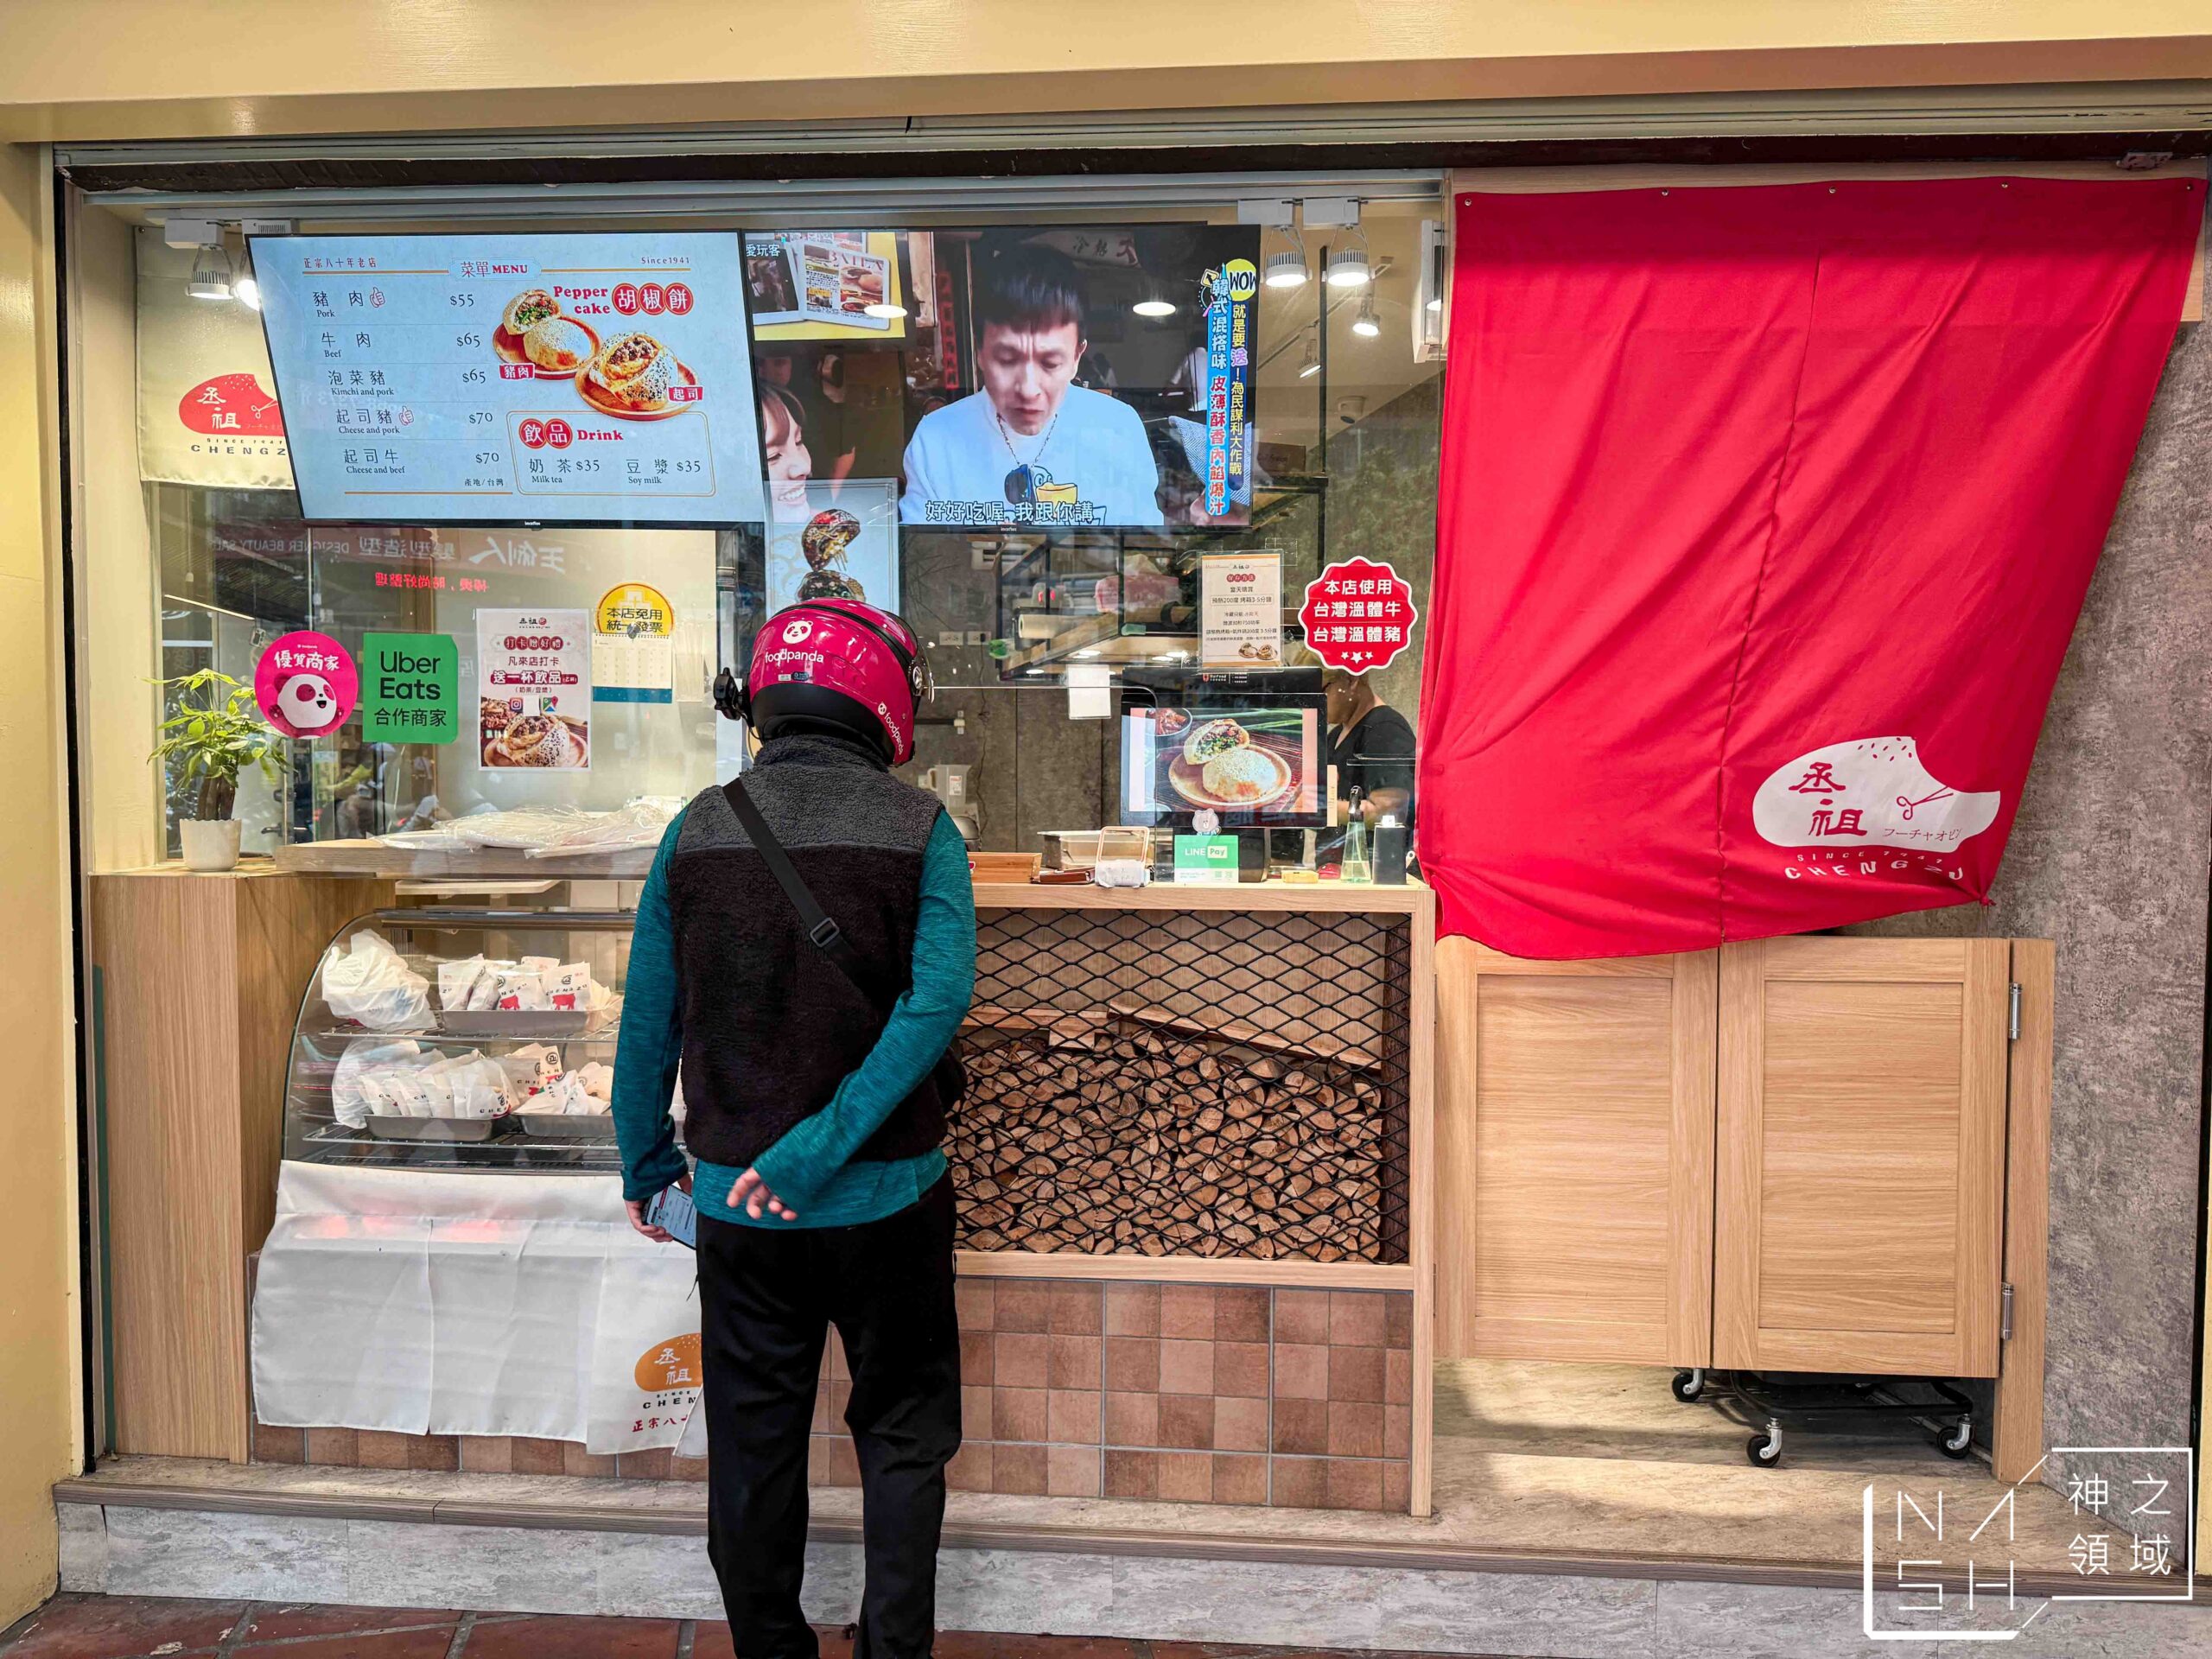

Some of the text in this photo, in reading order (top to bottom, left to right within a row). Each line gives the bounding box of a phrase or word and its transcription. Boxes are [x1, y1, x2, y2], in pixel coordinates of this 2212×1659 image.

[746, 244, 780, 257] 愛玩客
[303, 257, 377, 268] 正宗八十年老店
[461, 261, 528, 277] 菜單 MENU
[553, 286, 608, 300] Pepper
[616, 287, 689, 311] 胡椒餅
[450, 294, 474, 308] $55
[316, 309, 335, 318] Pork
[574, 303, 611, 314] cake
[456, 333, 480, 347] $65
[327, 370, 385, 385] 泡菜豬
[462, 368, 486, 384] $65
[505, 365, 529, 378] 豬肉
[377, 388, 394, 397] pork
[673, 387, 698, 400] 起司
[337, 409, 392, 424] 起司豬
[469, 412, 493, 424] $70
[383, 426, 400, 435] pork
[524, 423, 568, 444] 飲品
[577, 429, 623, 441] Drink
[345, 449, 399, 464] 起司牛
[475, 453, 499, 464] $70
[576, 460, 600, 472] $35
[677, 460, 701, 473] $35
[628, 476, 642, 486] Soy
[925, 500, 1094, 523] 好好吃喔 我跟你講
[1324, 579, 1393, 595] 本店使用
[607, 607, 663, 620] 本店免用
[1313, 601, 1402, 618] 台灣溫體牛
[1313, 626, 1401, 643] 台灣溫體豬
[274, 650, 340, 671] 優質商家
[380, 651, 442, 674] Uber
[508, 656, 559, 666] 凡來店打卡
[766, 648, 823, 664] foodpanda
[493, 671, 562, 683] 送一杯飲品
[380, 677, 441, 700] Eats
[374, 708, 447, 727] 合作商家
[1789, 761, 1867, 836] 丞祖
[1185, 848, 1225, 856] LINE Pay
[1797, 851, 1865, 861] SINCE
